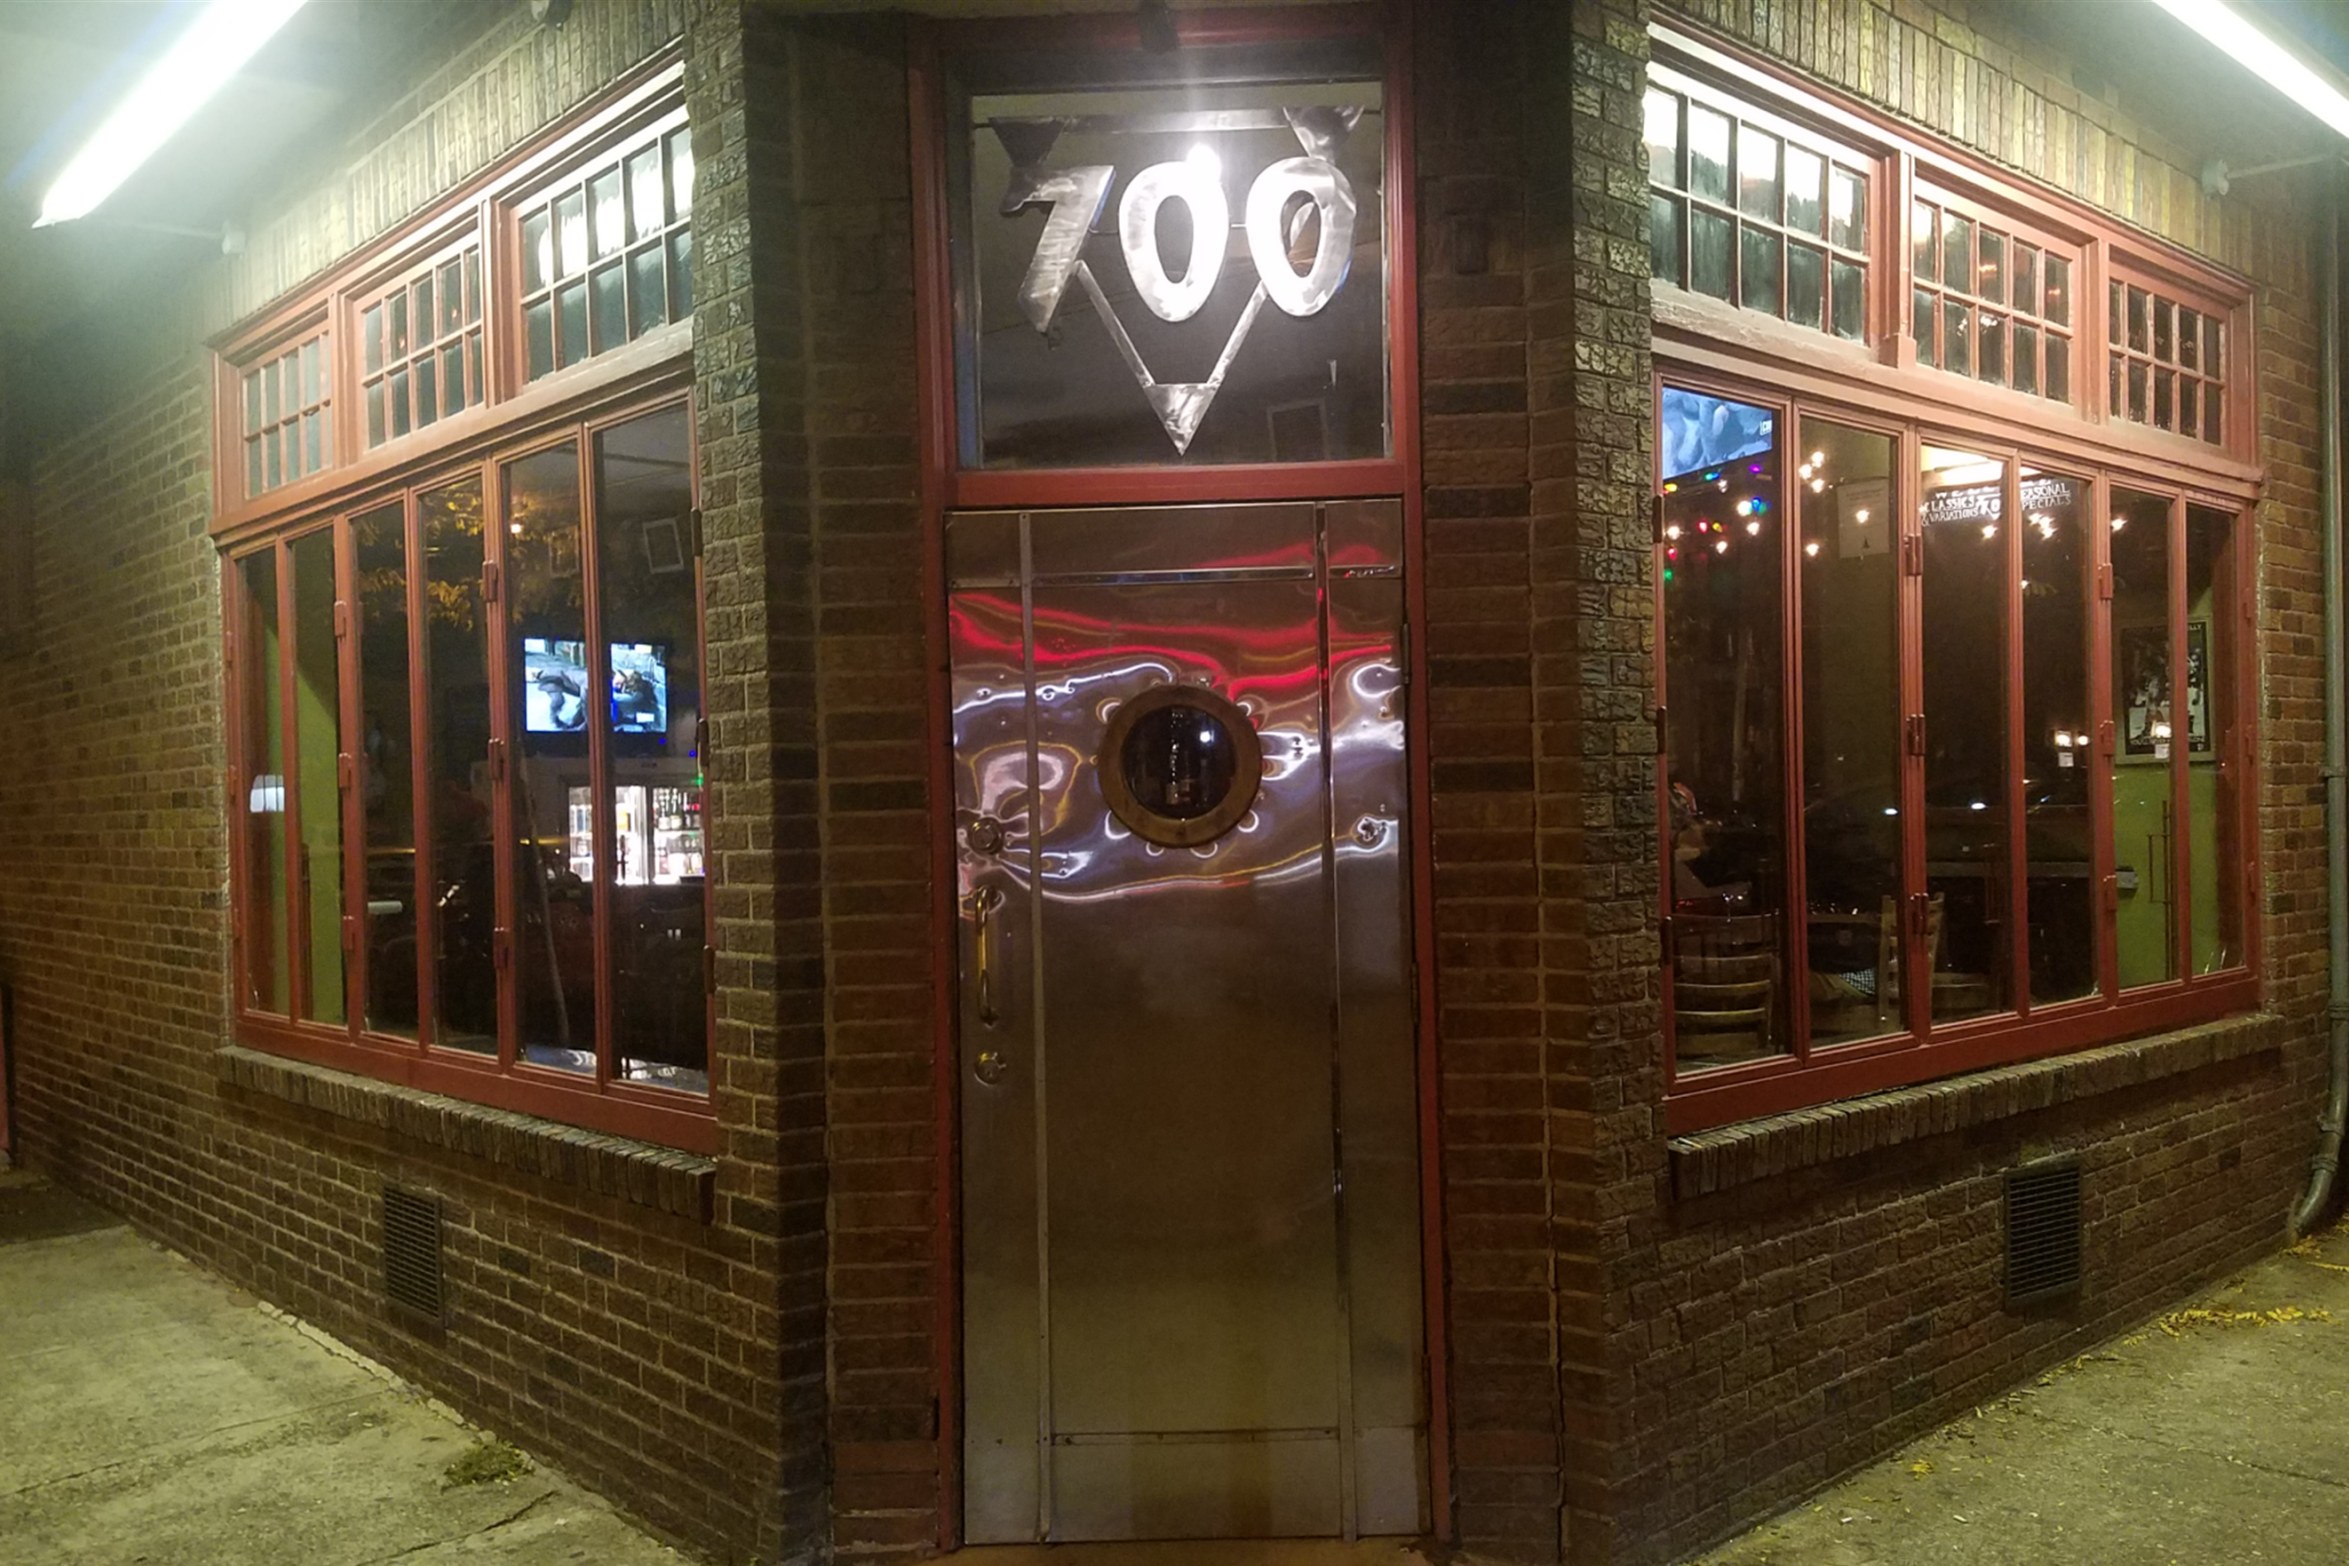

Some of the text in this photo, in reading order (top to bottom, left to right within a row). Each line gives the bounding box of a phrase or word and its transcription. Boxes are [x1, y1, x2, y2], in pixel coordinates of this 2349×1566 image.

[1001, 156, 1358, 333] 700
[2020, 482, 2070, 500] EASONAL
[2020, 493, 2071, 510] PECIALS
